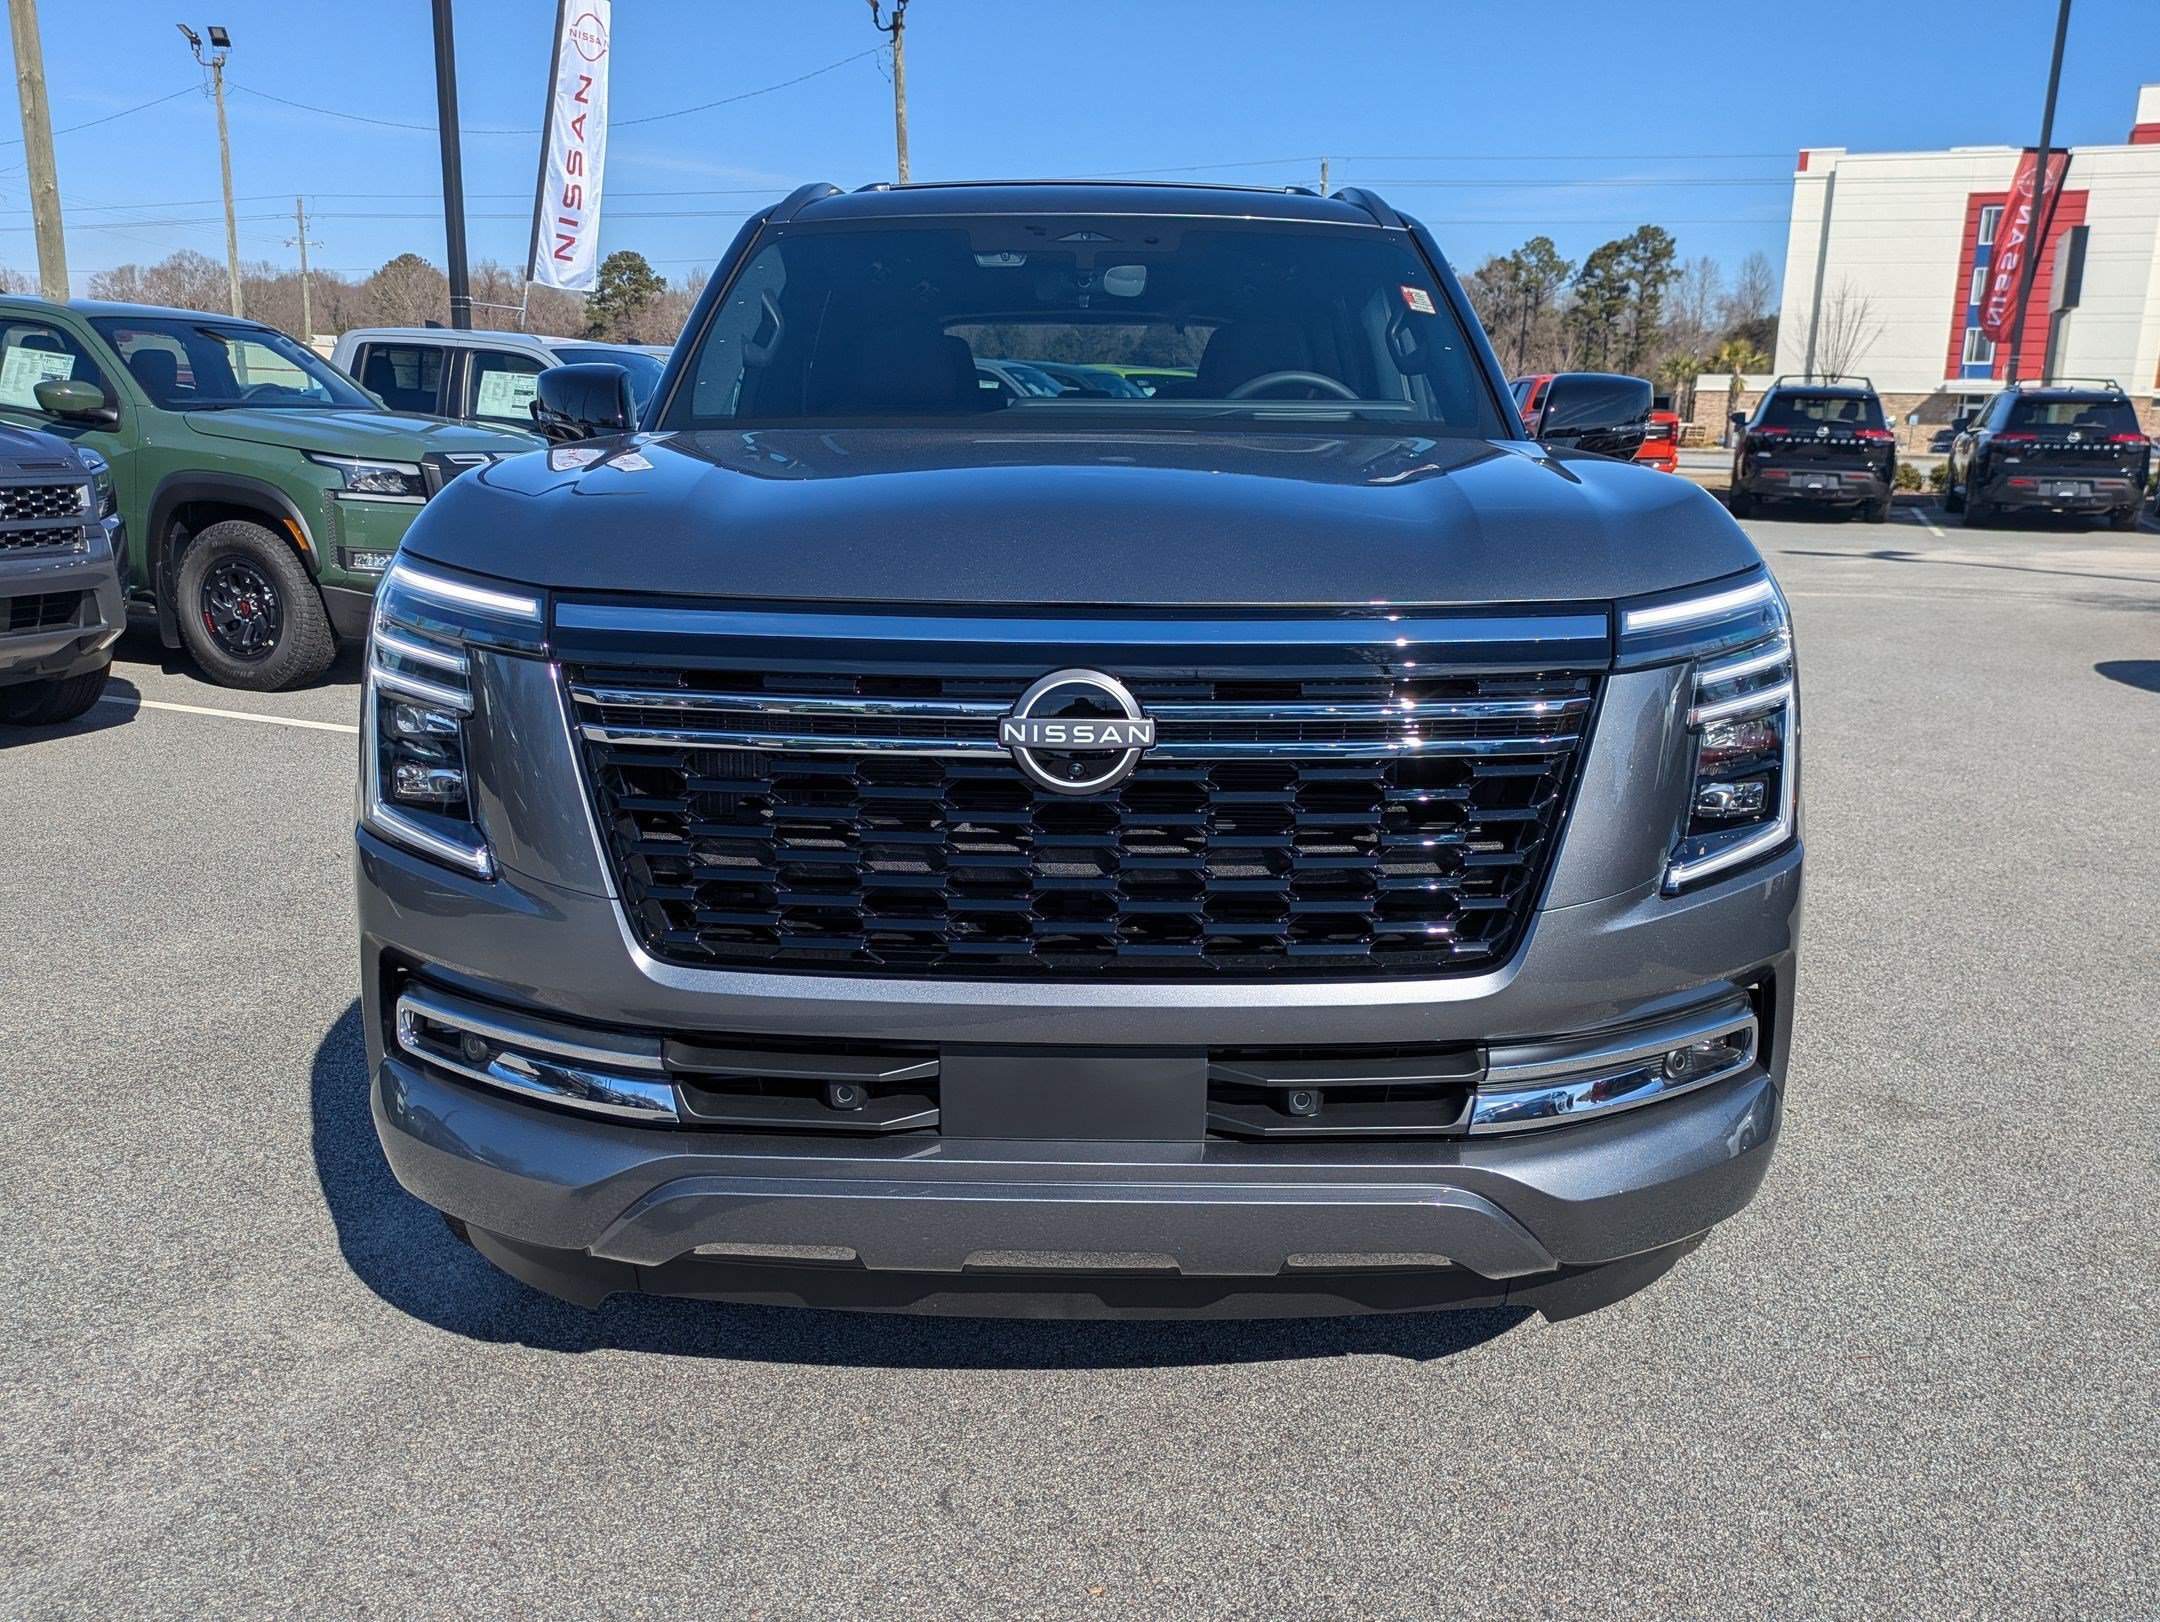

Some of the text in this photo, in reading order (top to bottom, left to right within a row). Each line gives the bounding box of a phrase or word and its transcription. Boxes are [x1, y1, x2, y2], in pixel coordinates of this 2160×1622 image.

[569, 28, 610, 48] NISSAN
[553, 74, 593, 262] NISSAN
[1004, 723, 1150, 744] NISSAN
